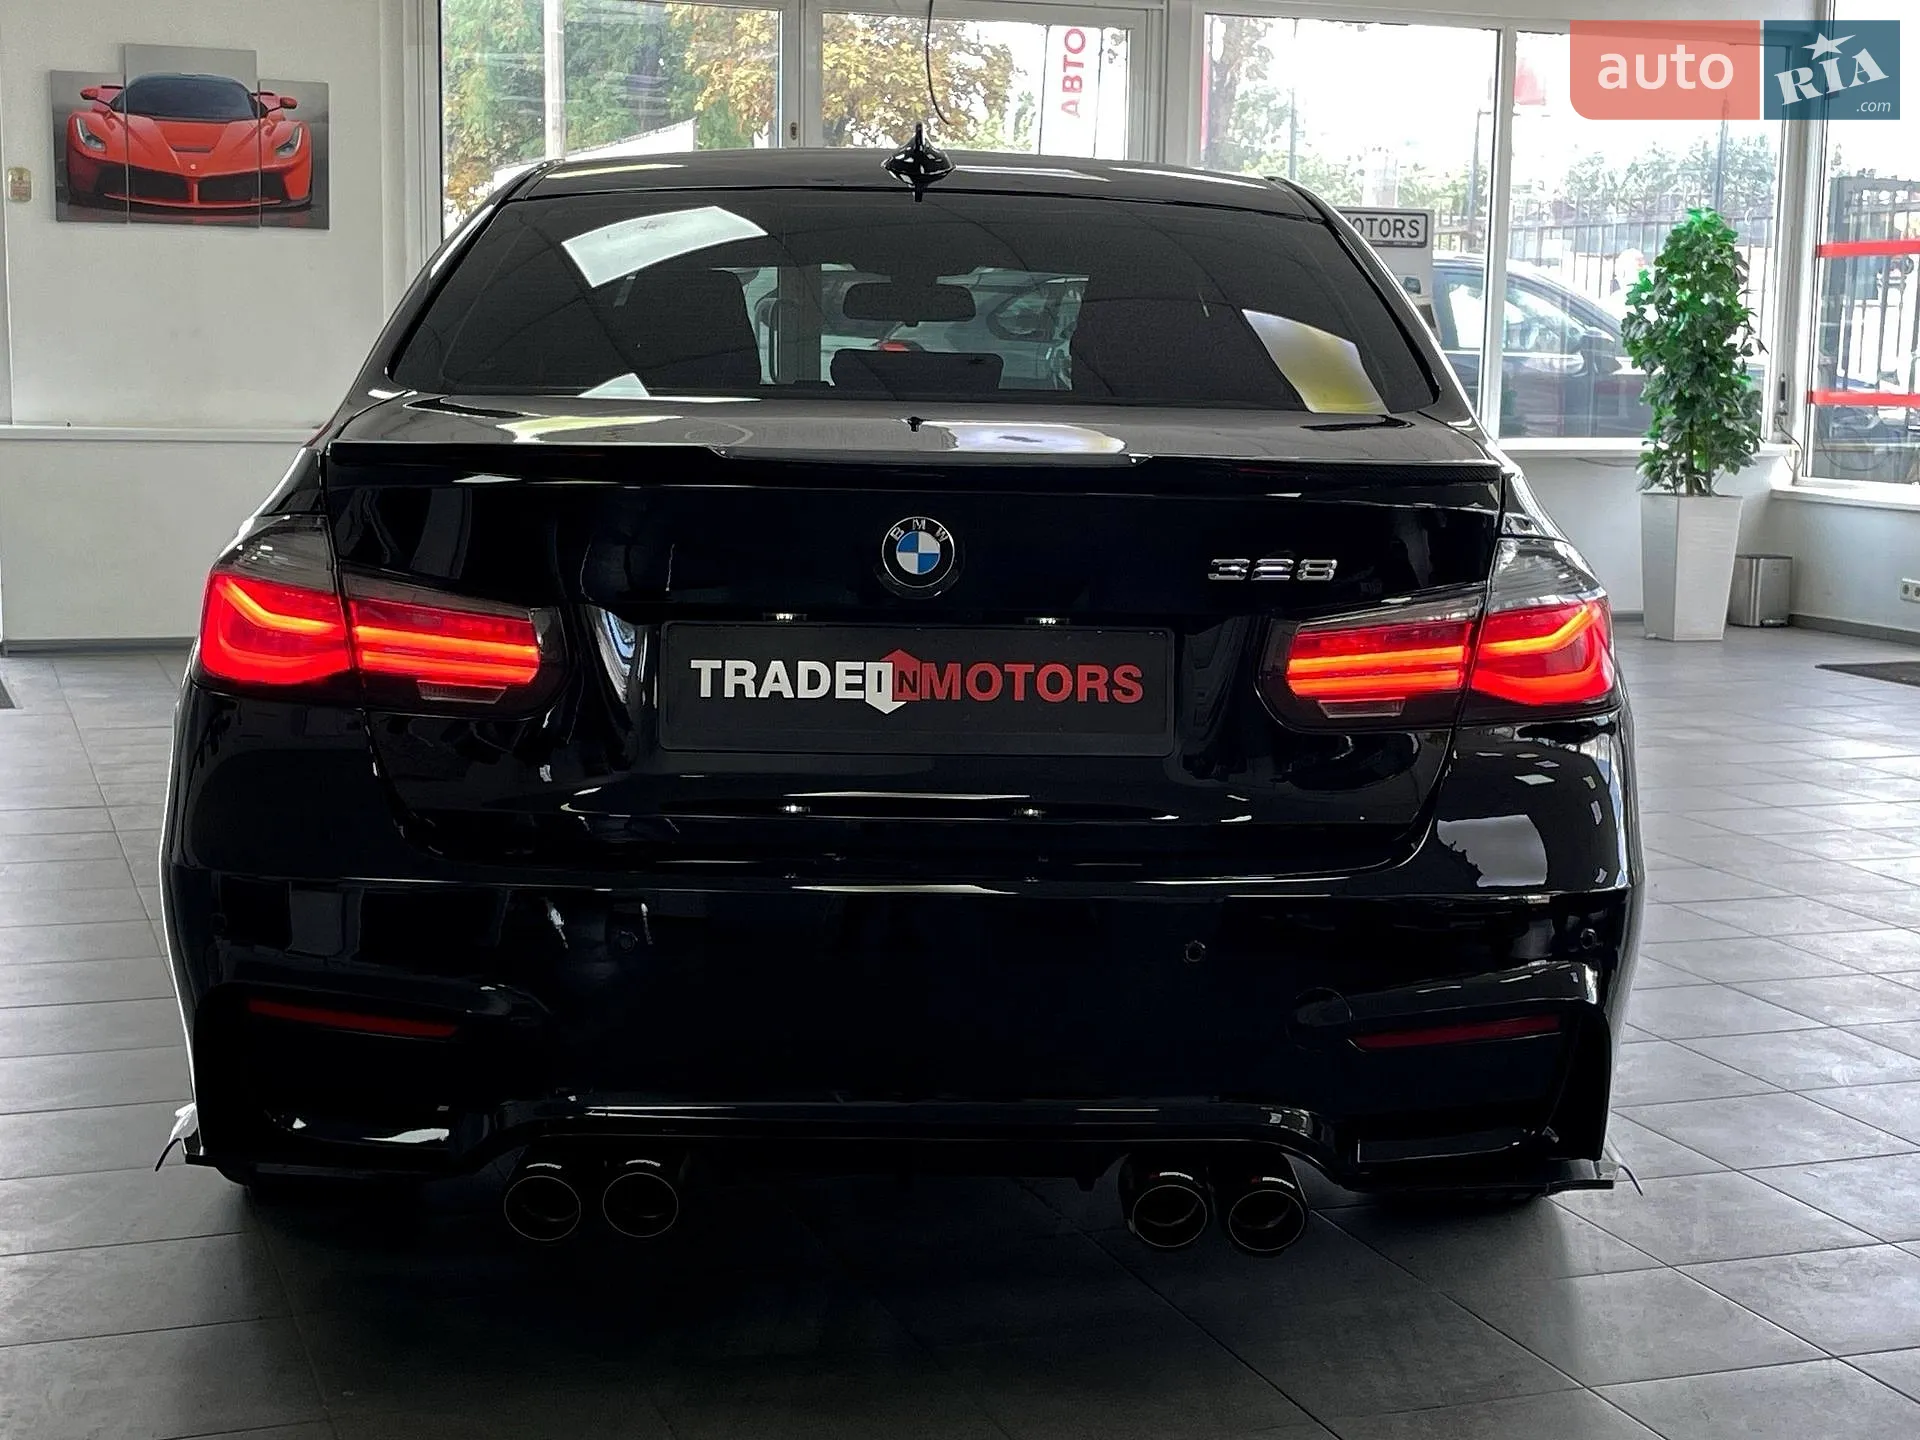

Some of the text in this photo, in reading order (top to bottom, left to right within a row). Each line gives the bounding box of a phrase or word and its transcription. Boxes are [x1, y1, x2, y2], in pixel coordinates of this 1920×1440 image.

[1346, 217, 1420, 239] OTORS
[890, 518, 949, 542] BMW
[1208, 558, 1338, 581] 328
